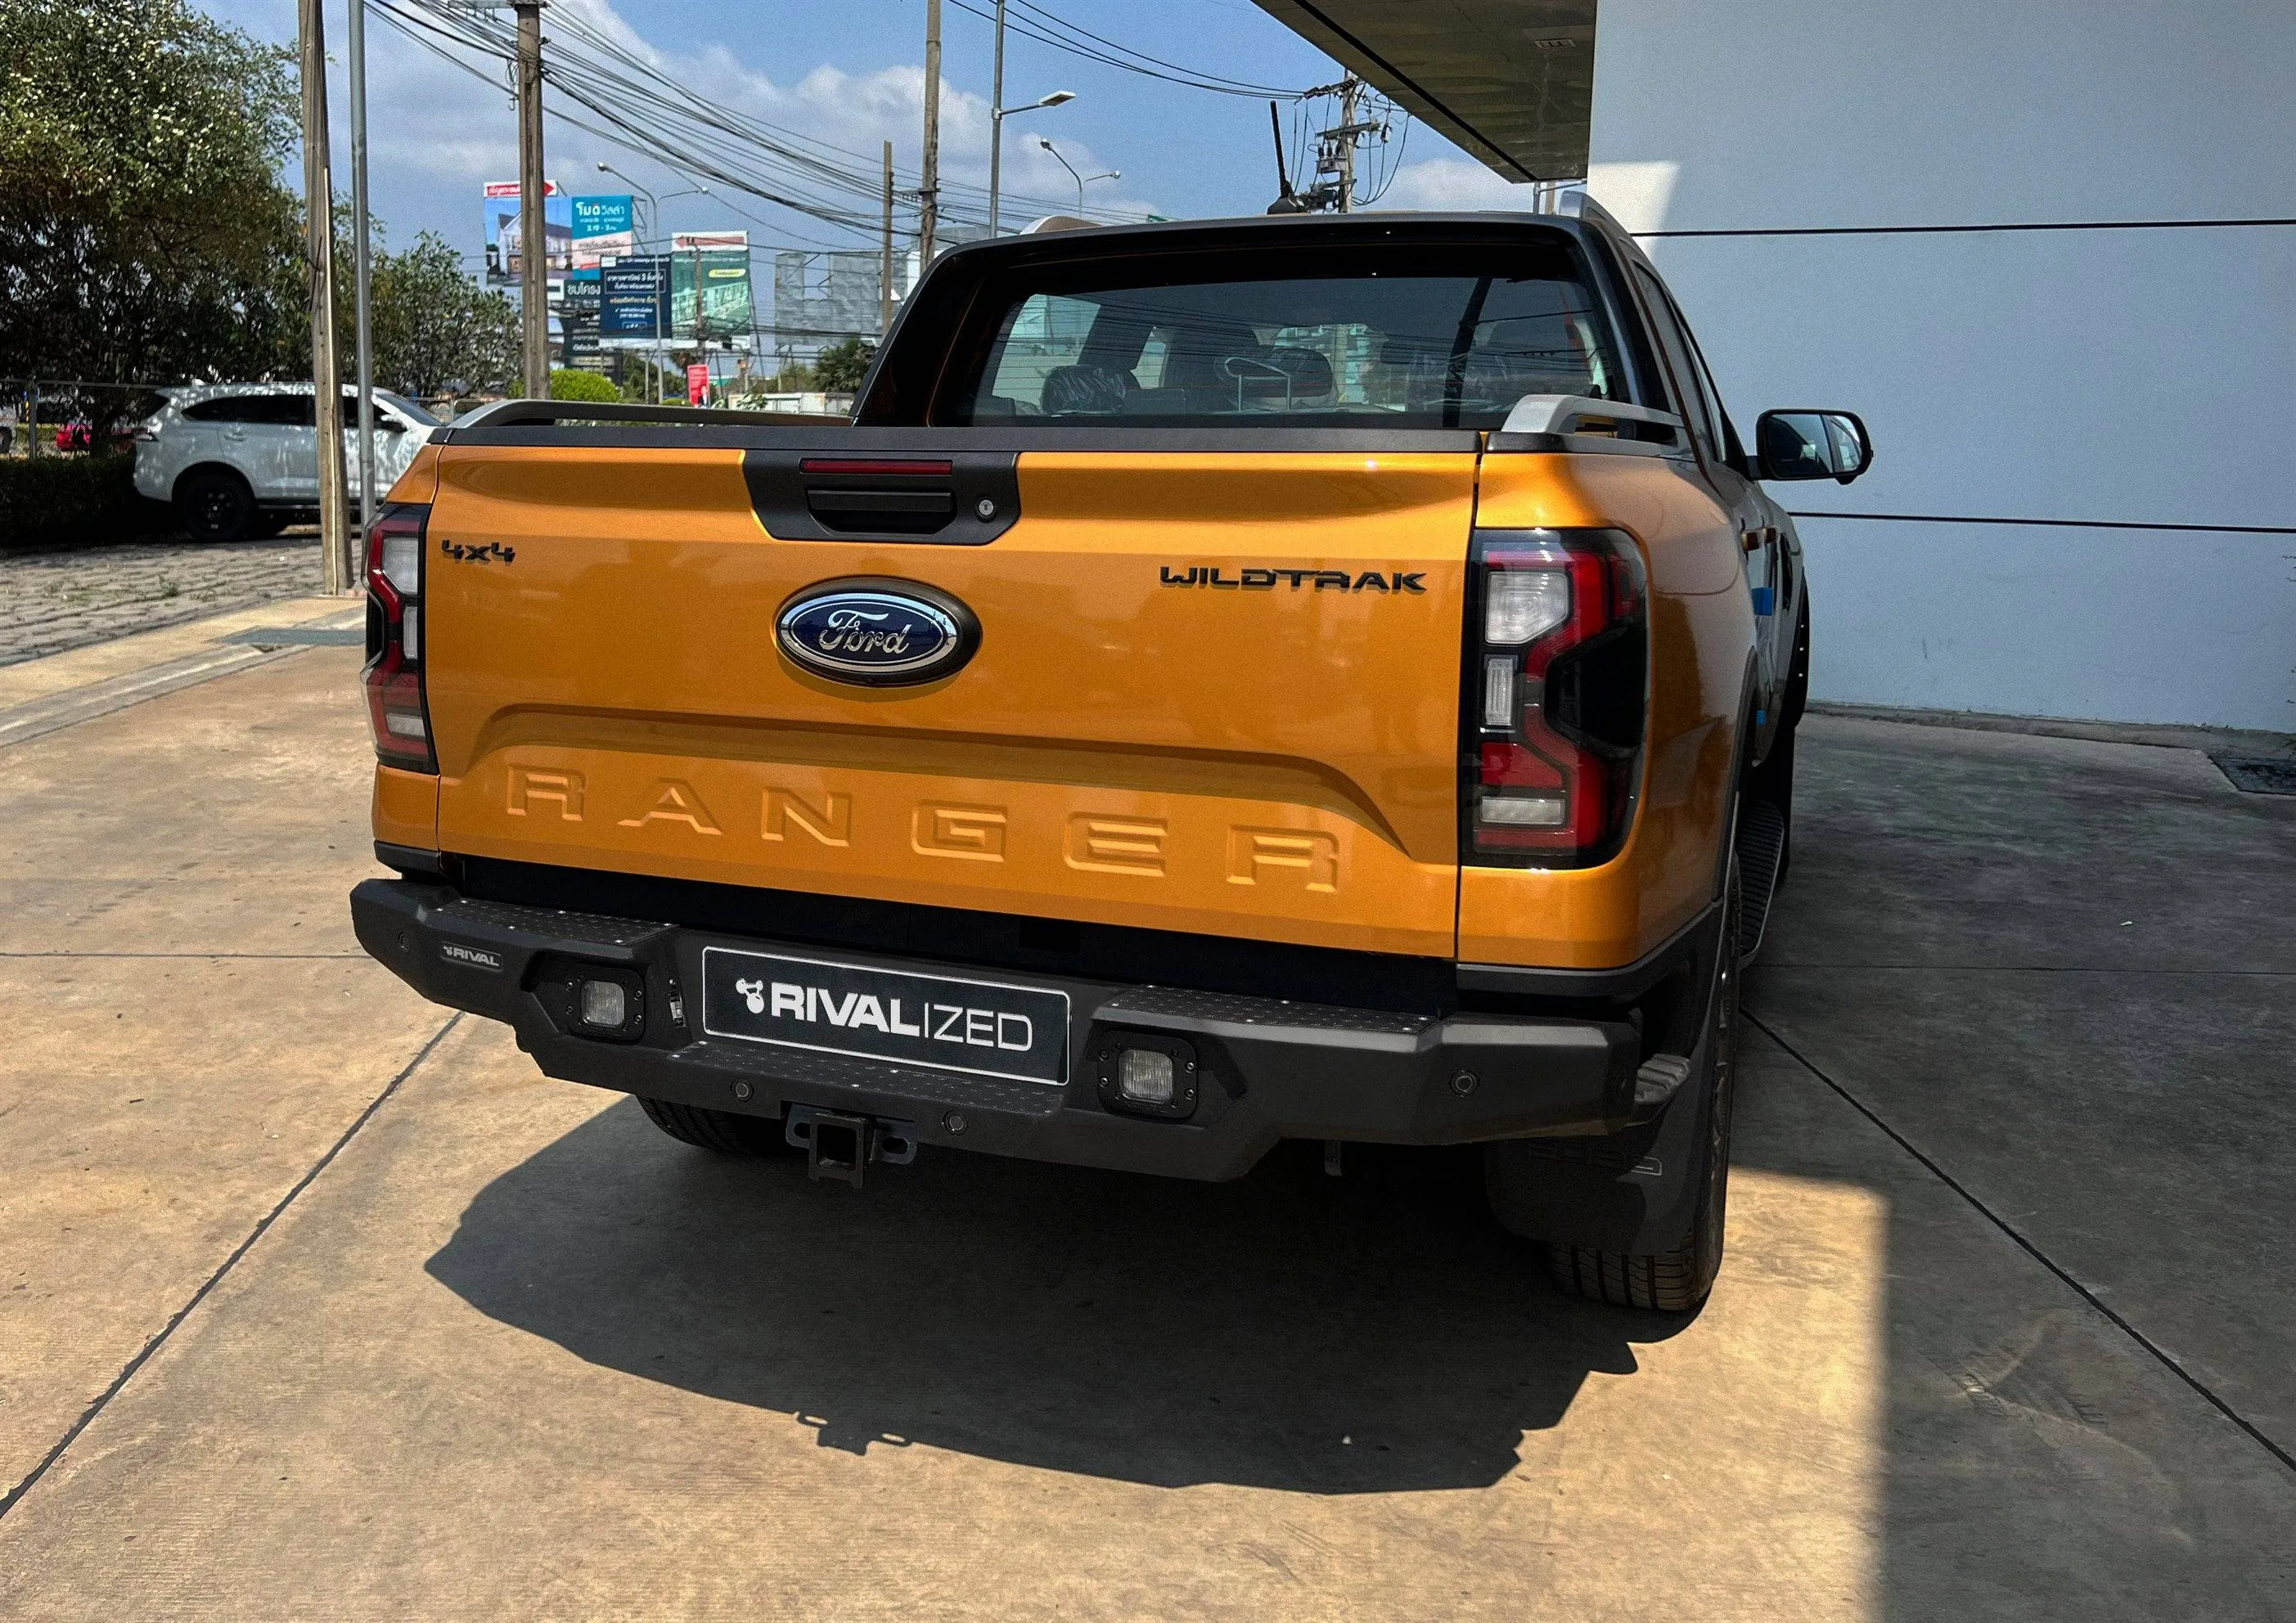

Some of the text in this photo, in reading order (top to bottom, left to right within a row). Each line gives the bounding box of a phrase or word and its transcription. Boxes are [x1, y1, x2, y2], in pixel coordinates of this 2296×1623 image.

[1159, 566, 1427, 591] WILDTRAK
[819, 609, 912, 654] Ford
[506, 762, 1340, 893] RANGER
[453, 947, 500, 967] RIVAL
[771, 982, 1033, 1053] RIVALIZED
